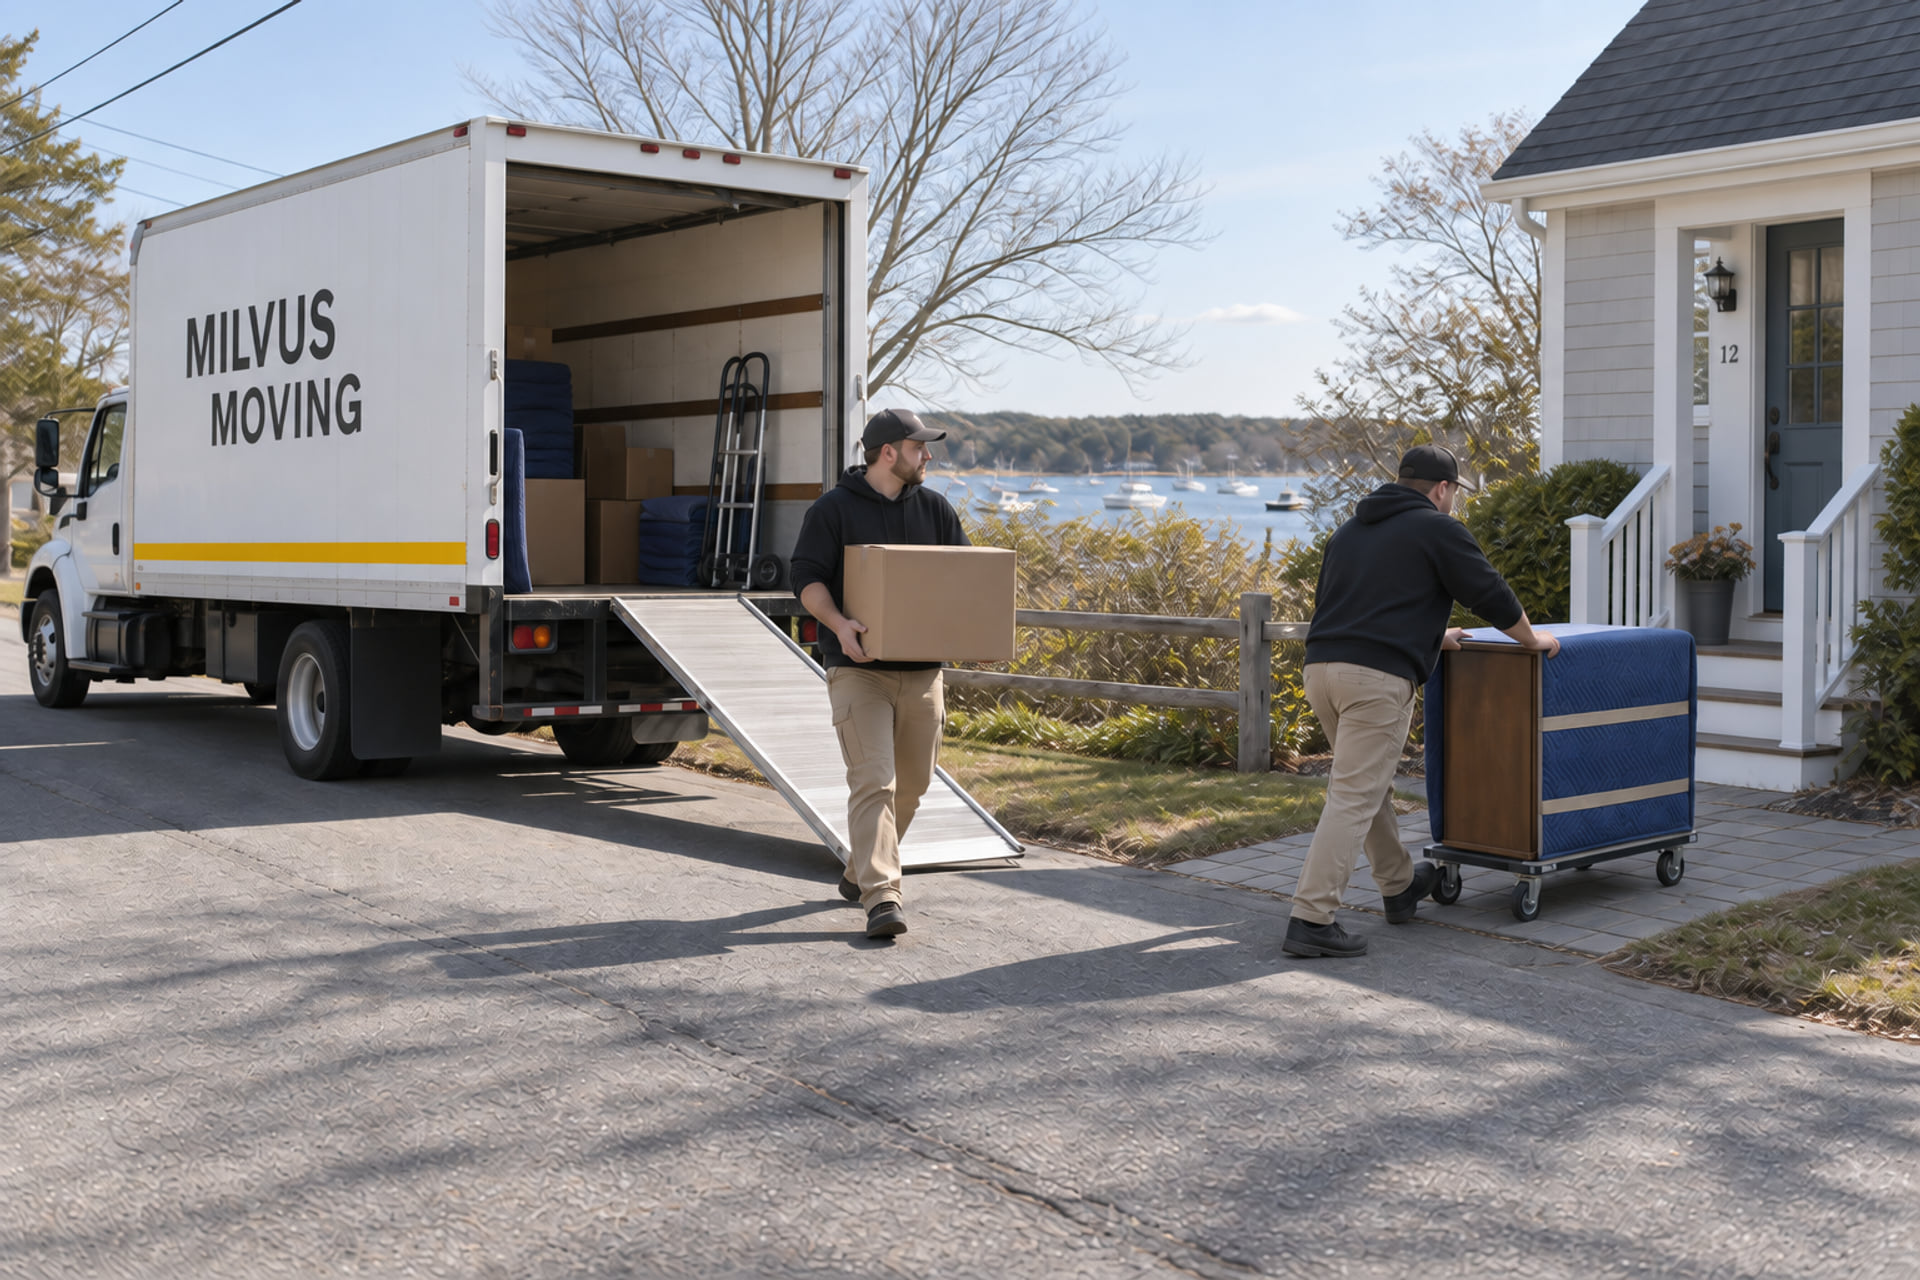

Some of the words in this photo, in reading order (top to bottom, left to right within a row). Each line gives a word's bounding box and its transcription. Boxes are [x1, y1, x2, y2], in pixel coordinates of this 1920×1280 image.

[185, 288, 336, 379] MILVUS
[1720, 344, 1739, 364] 12
[211, 372, 362, 447] MOVING
